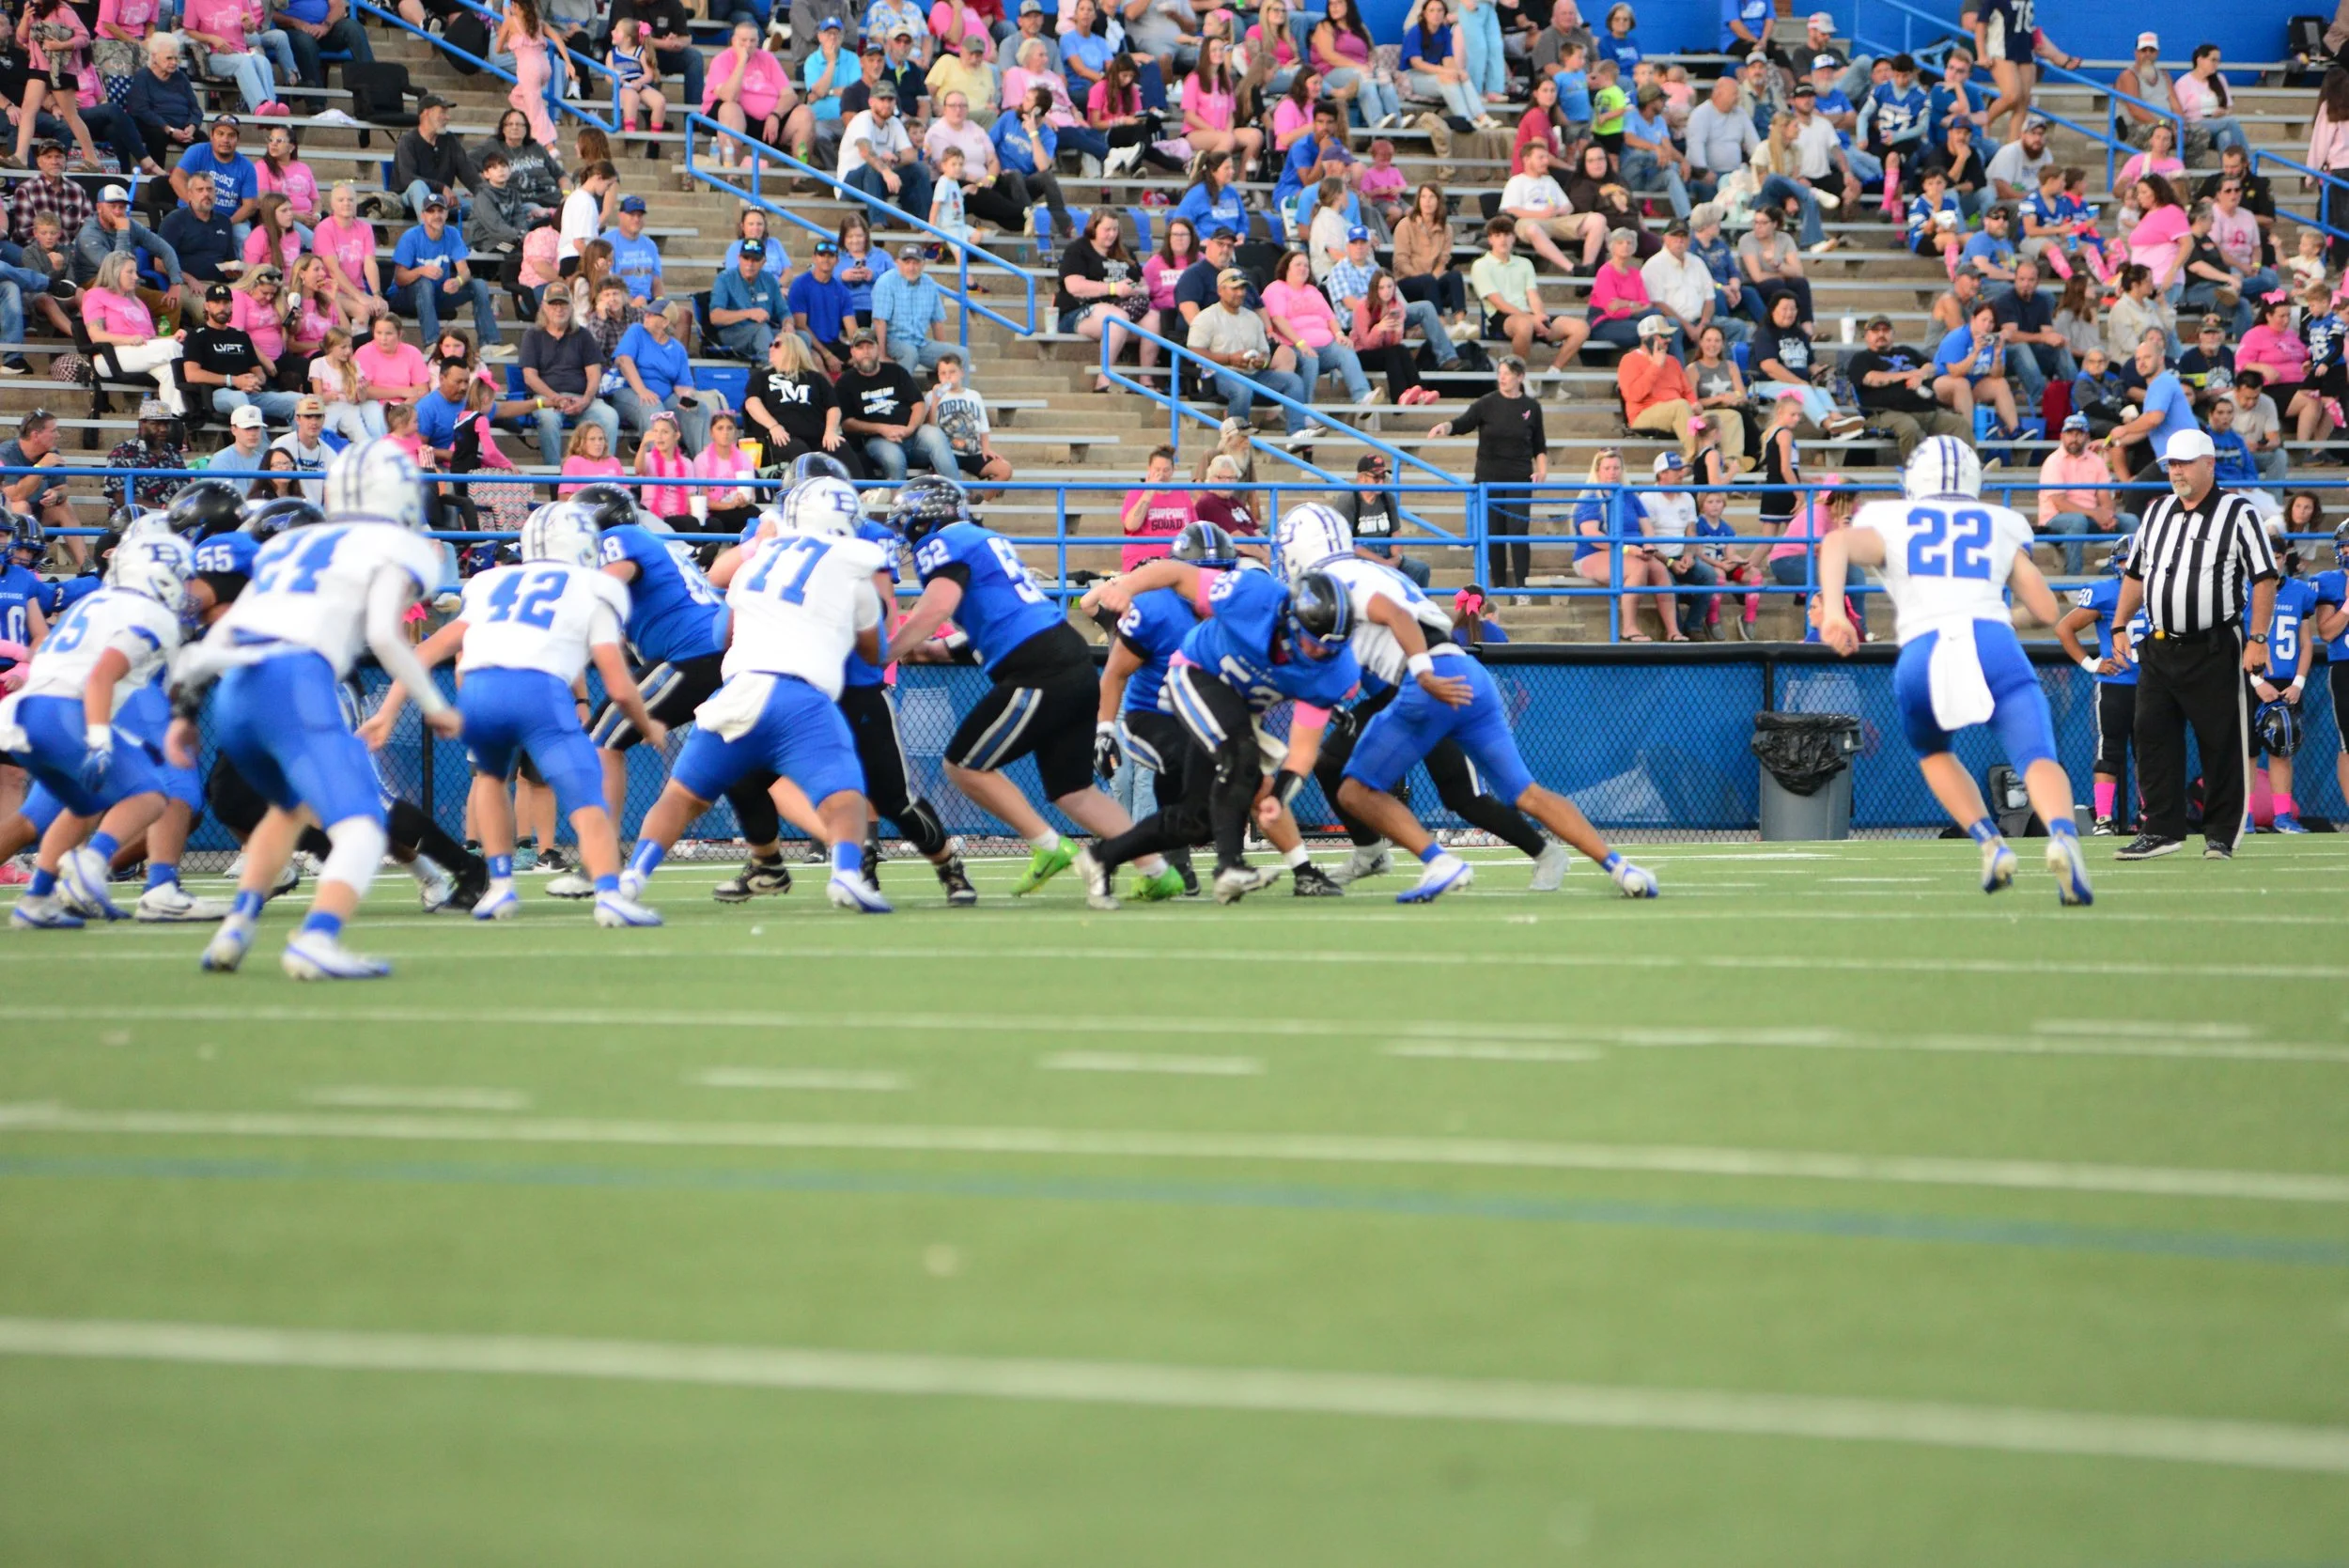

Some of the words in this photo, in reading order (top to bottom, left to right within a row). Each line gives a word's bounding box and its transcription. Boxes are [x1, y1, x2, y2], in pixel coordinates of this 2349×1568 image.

[1148, 507, 1188, 520] SUPPORT
[196, 544, 234, 572] 55
[915, 537, 953, 575] 52
[1906, 506, 1992, 581] 22
[746, 536, 834, 606] 77
[487, 569, 569, 631] 42
[2272, 615, 2298, 660] 5
